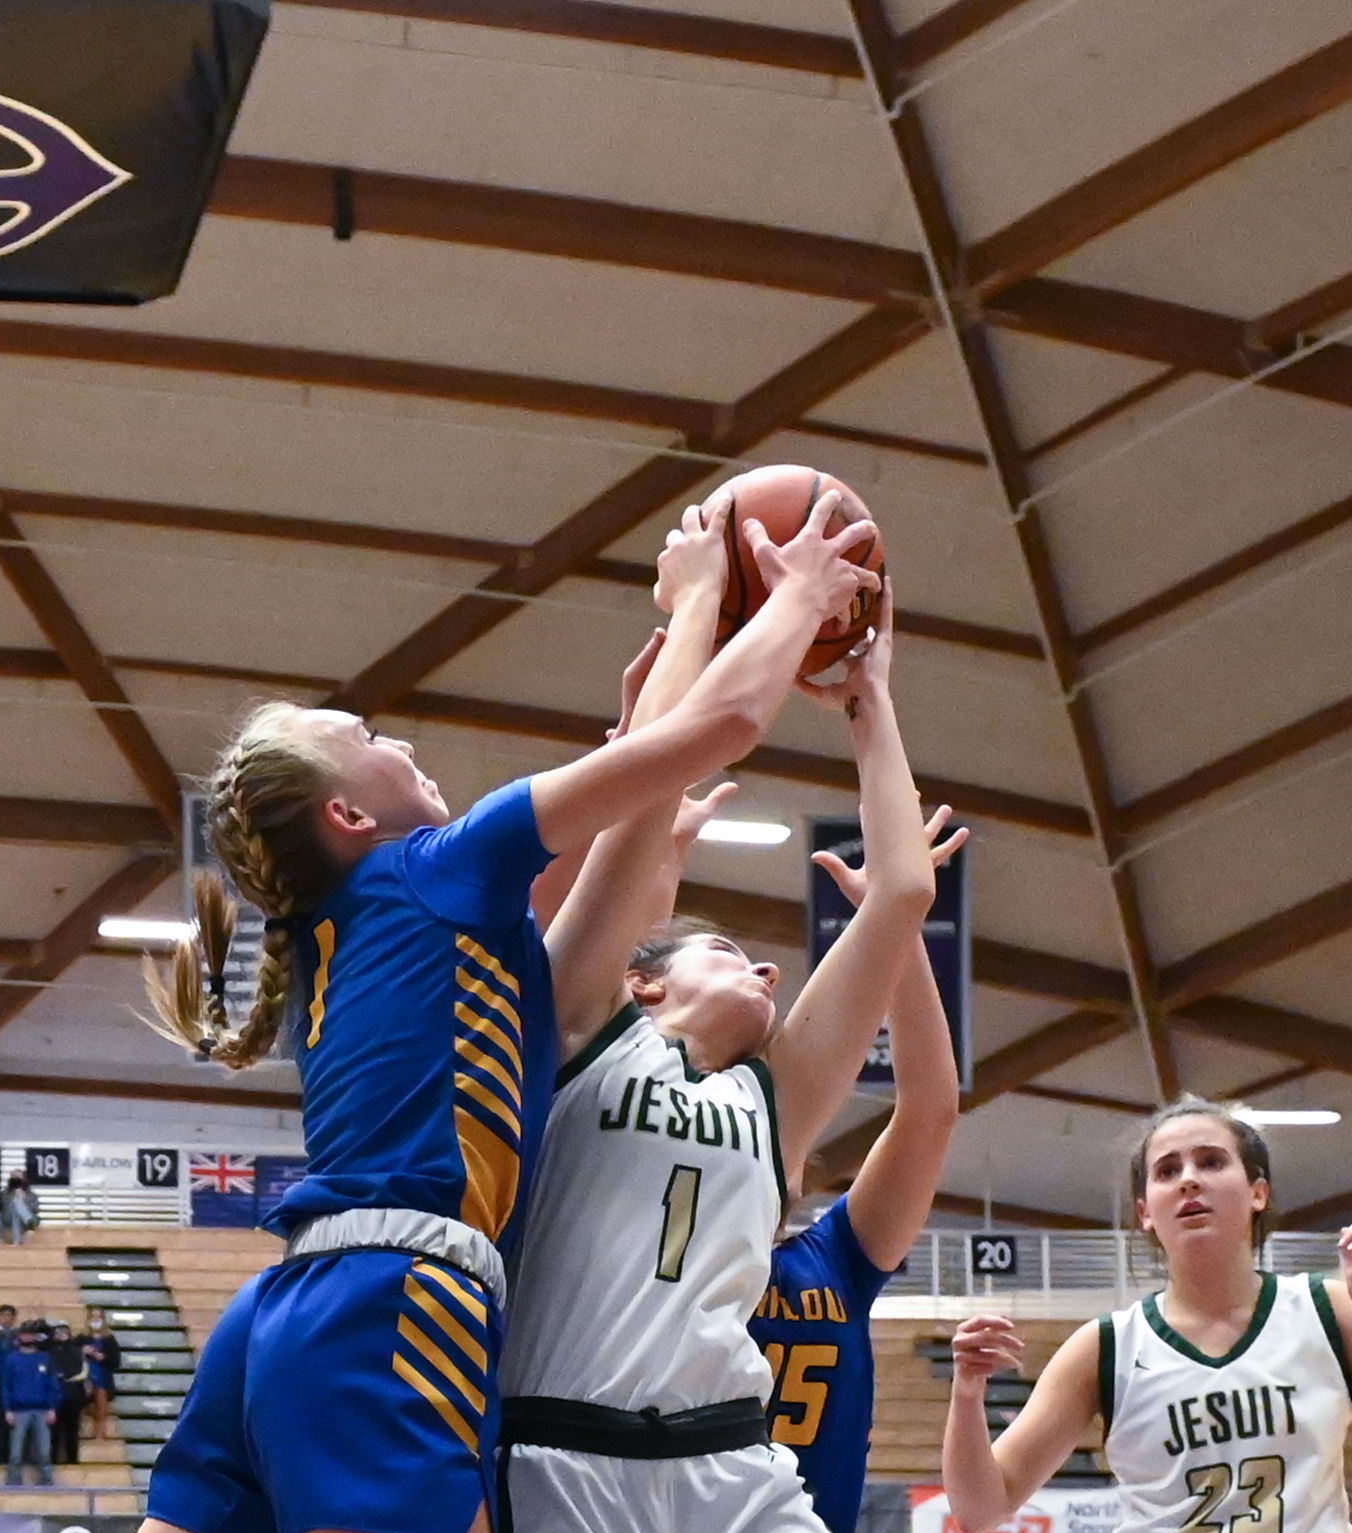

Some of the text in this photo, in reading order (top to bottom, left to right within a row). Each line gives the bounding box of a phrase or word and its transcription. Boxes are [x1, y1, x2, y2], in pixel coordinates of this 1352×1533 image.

[307, 918, 335, 1049] 1
[600, 1077, 761, 1161] JESUIT
[34, 1153, 60, 1179] 18
[142, 1153, 172, 1182] 19
[655, 1165, 701, 1283] 1
[975, 1240, 1012, 1270] 20
[1163, 1385, 1298, 1457] JESUIT
